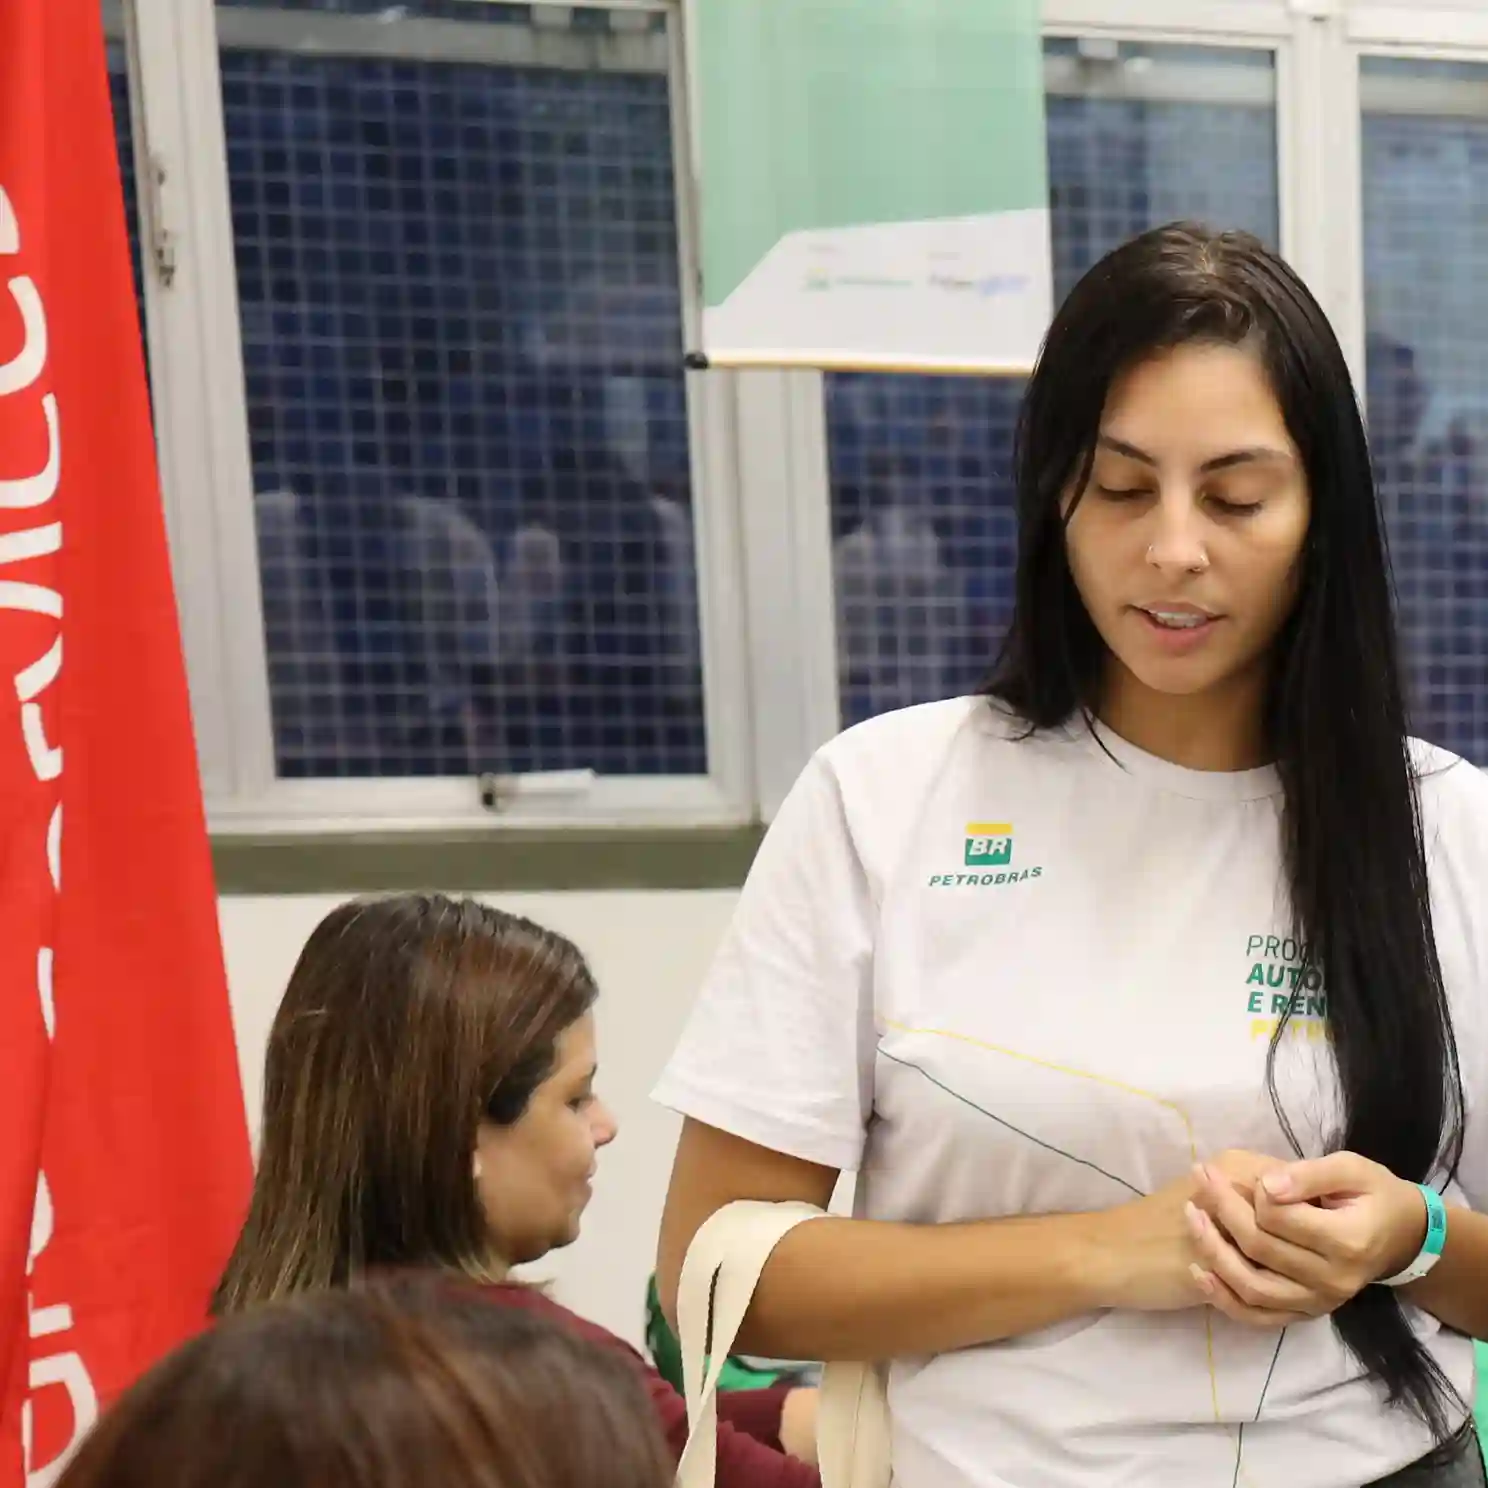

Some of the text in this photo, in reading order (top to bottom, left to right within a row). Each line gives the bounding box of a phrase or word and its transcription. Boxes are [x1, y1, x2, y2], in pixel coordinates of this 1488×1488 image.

[968, 838, 1007, 857] BR
[928, 865, 1043, 887] PETROBRAS
[1246, 934, 1308, 962] PRO
[1245, 962, 1322, 991] AUTO
[1247, 991, 1327, 1017] E REN
